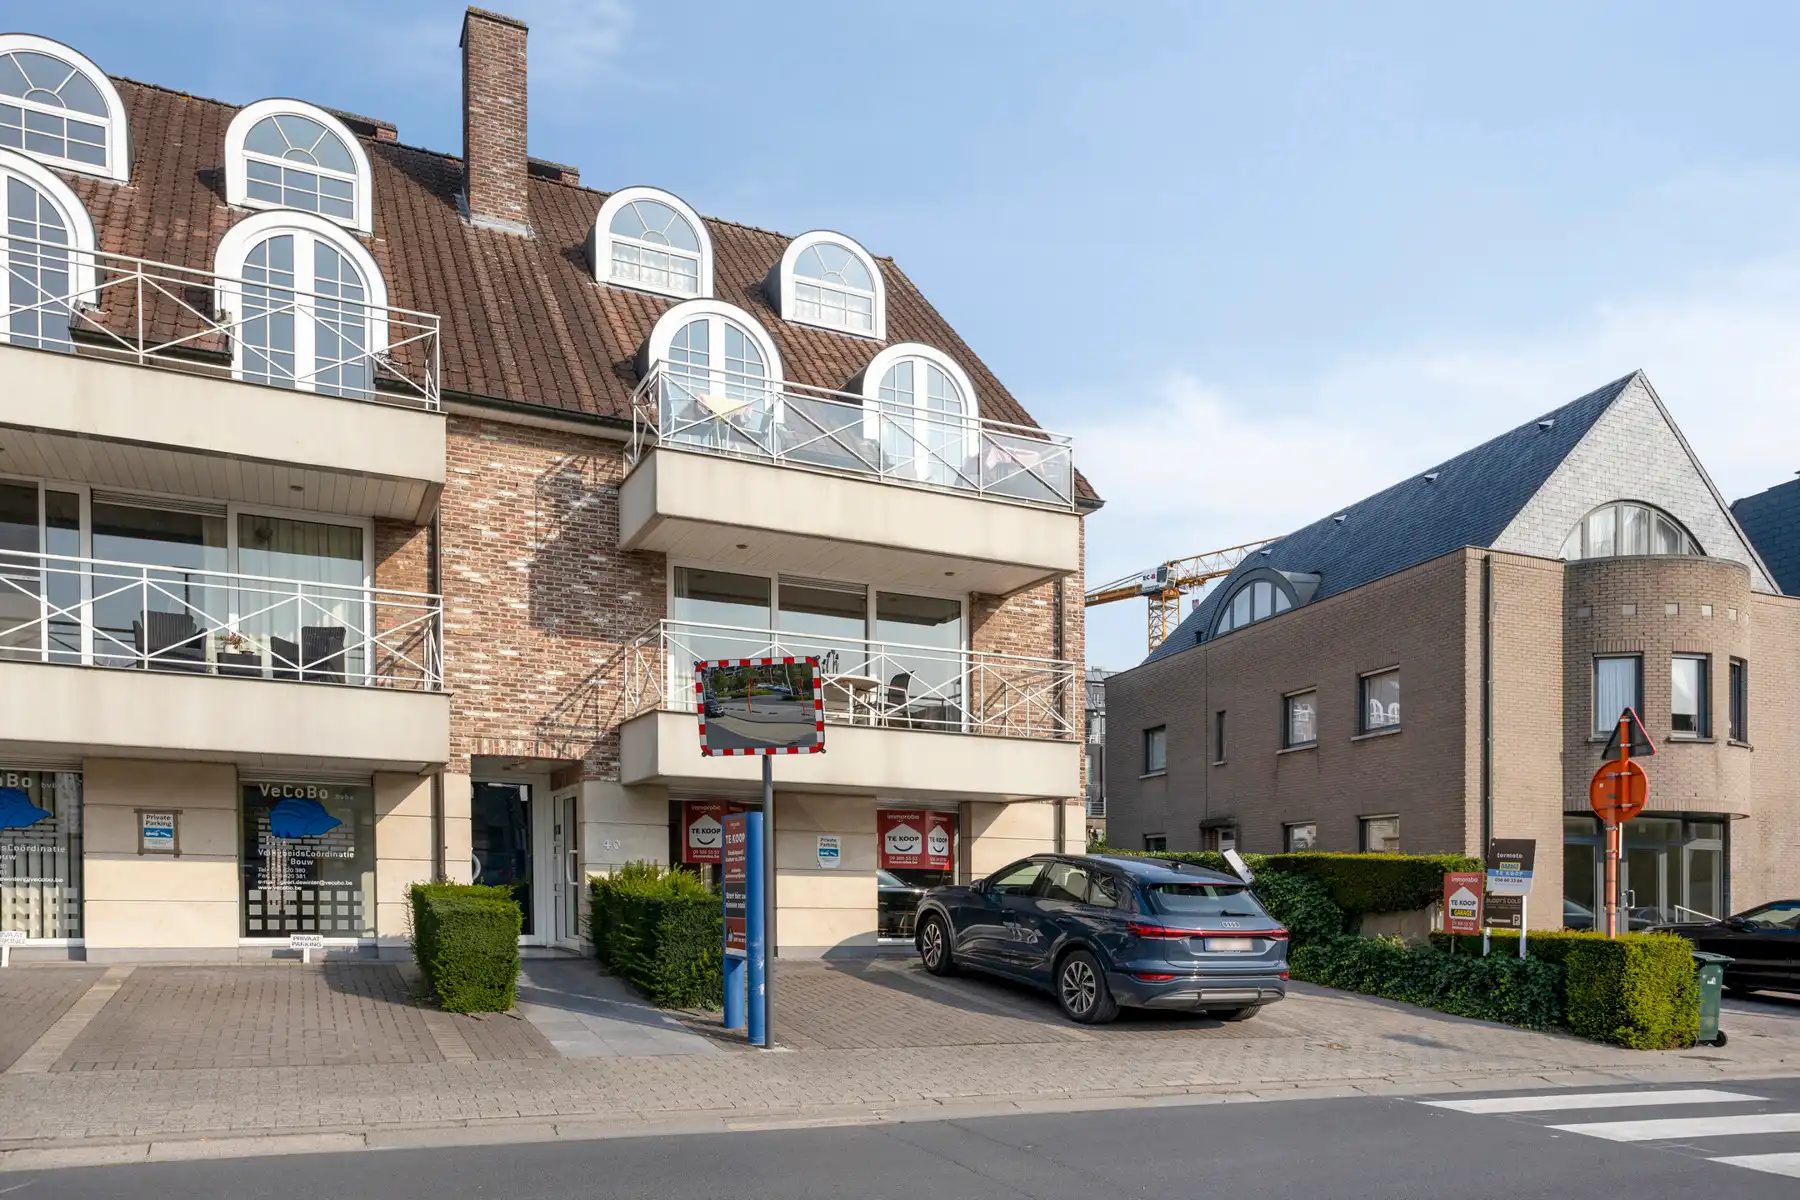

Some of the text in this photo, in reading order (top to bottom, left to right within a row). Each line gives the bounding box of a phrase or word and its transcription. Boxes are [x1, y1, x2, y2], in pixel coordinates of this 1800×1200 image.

[259, 783, 329, 799] VeCoBo
[145, 820, 172, 828] Parking
[602, 839, 621, 850] 40
[290, 858, 314, 866] Bouw
[1453, 909, 1473, 917] GARAGE
